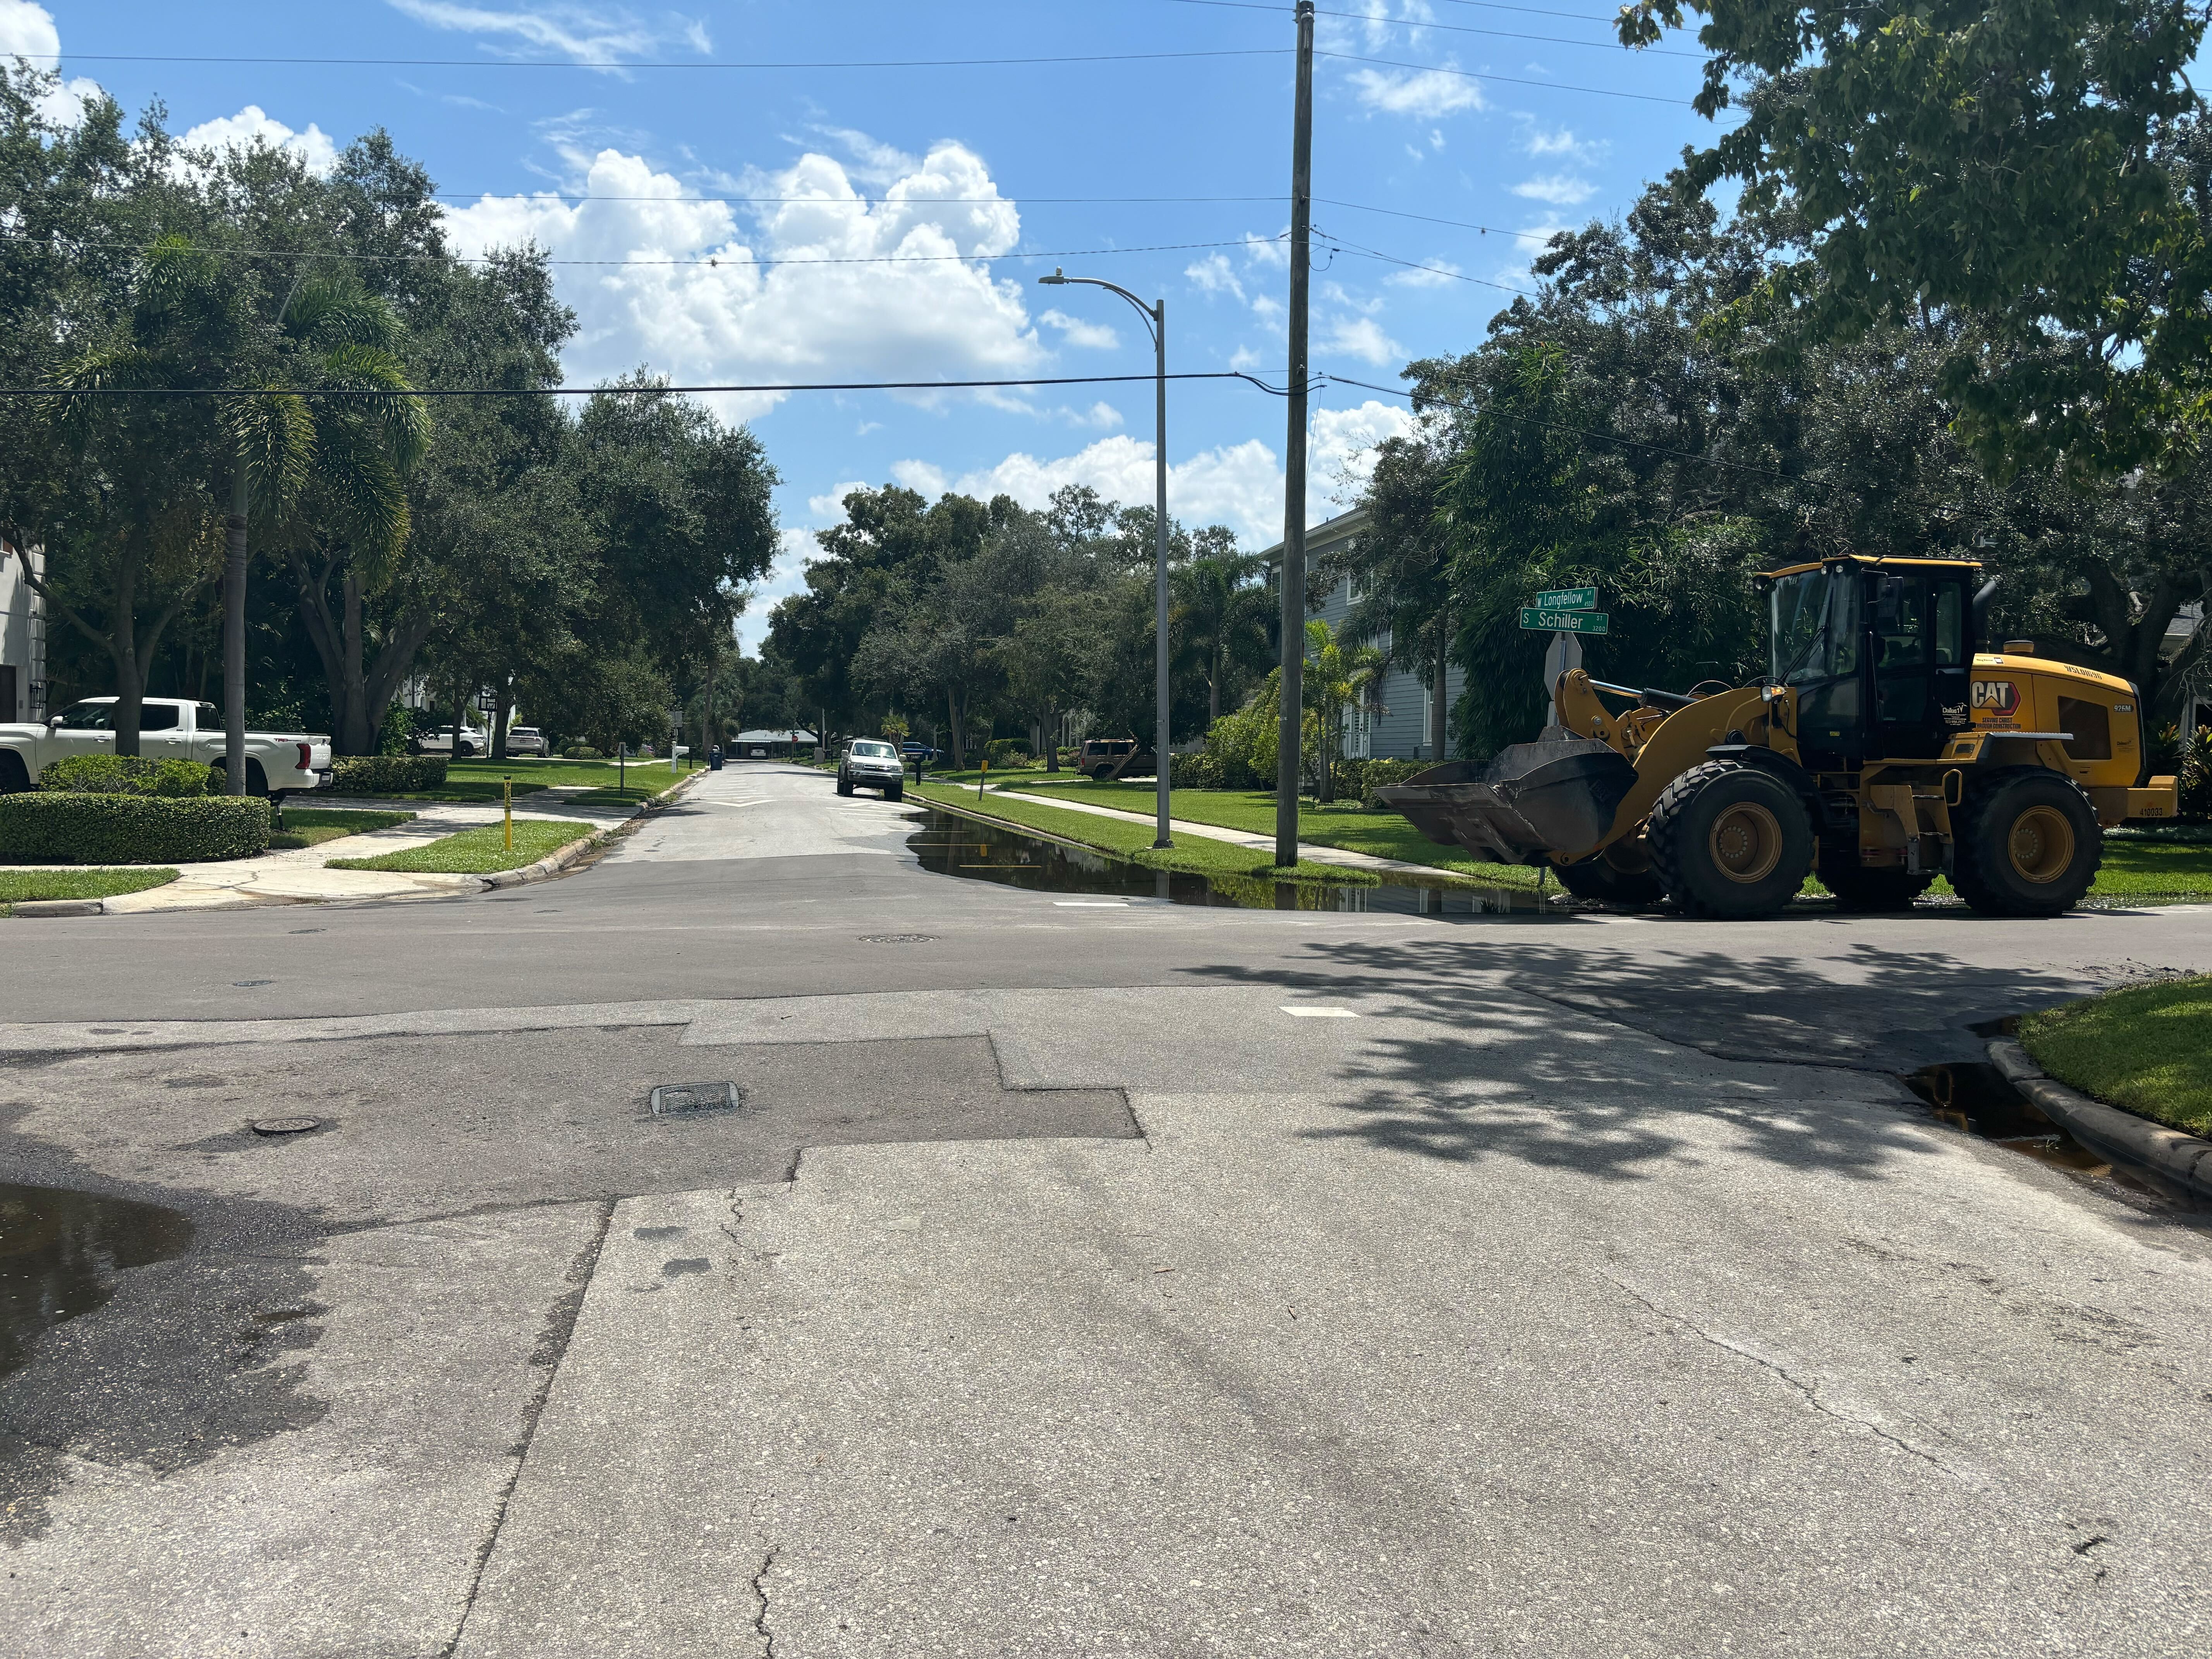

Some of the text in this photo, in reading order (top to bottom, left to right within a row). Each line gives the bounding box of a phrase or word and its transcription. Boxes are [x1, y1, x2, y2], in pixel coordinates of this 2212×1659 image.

[1537, 598, 1542, 608] W
[1544, 591, 1583, 609] Longfellow
[1523, 613, 1529, 623] S
[1538, 611, 1583, 629] Schiller
[1972, 682, 2009, 708] CAT
